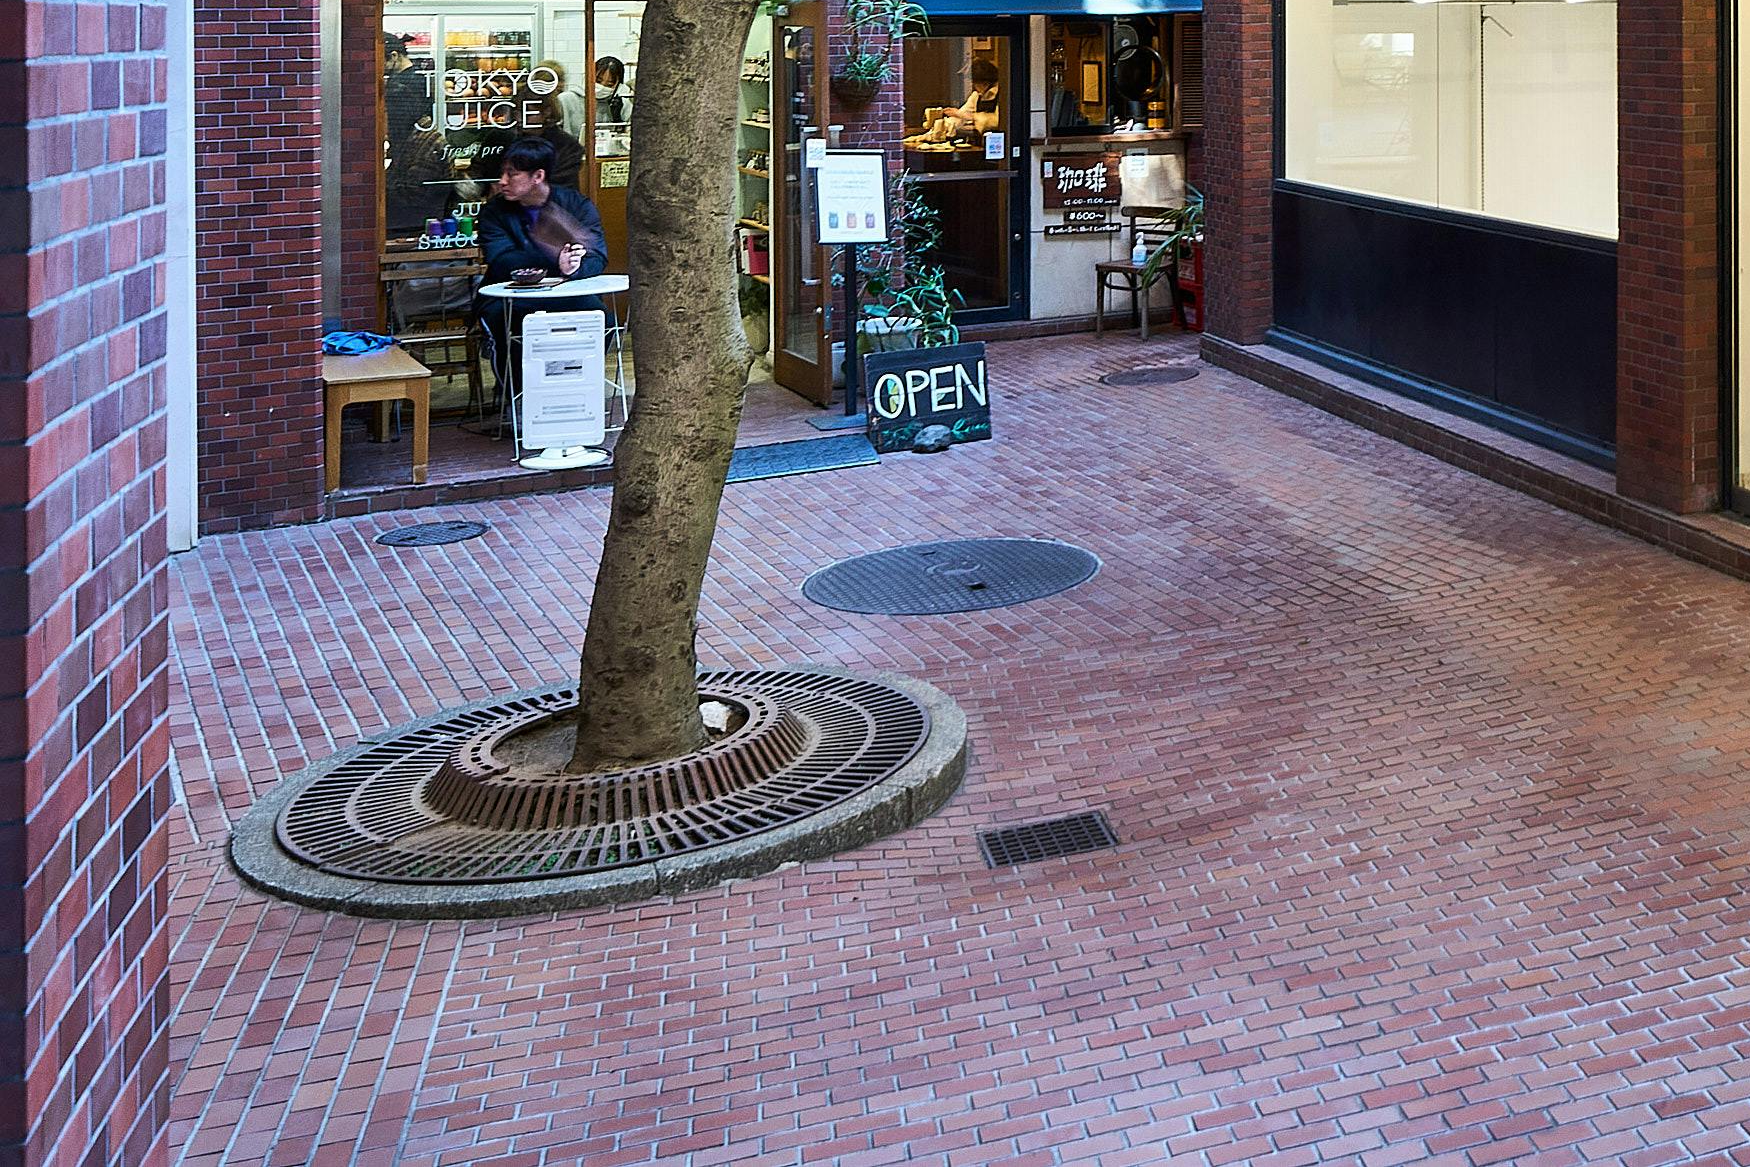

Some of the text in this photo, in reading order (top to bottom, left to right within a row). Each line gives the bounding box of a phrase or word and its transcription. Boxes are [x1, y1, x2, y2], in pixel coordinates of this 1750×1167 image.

[415, 66, 559, 98] TOKYO
[414, 100, 543, 132] JUICE
[441, 142, 481, 160] fresh
[1057, 161, 1108, 193] 珈琲
[873, 360, 987, 419] OPEN
